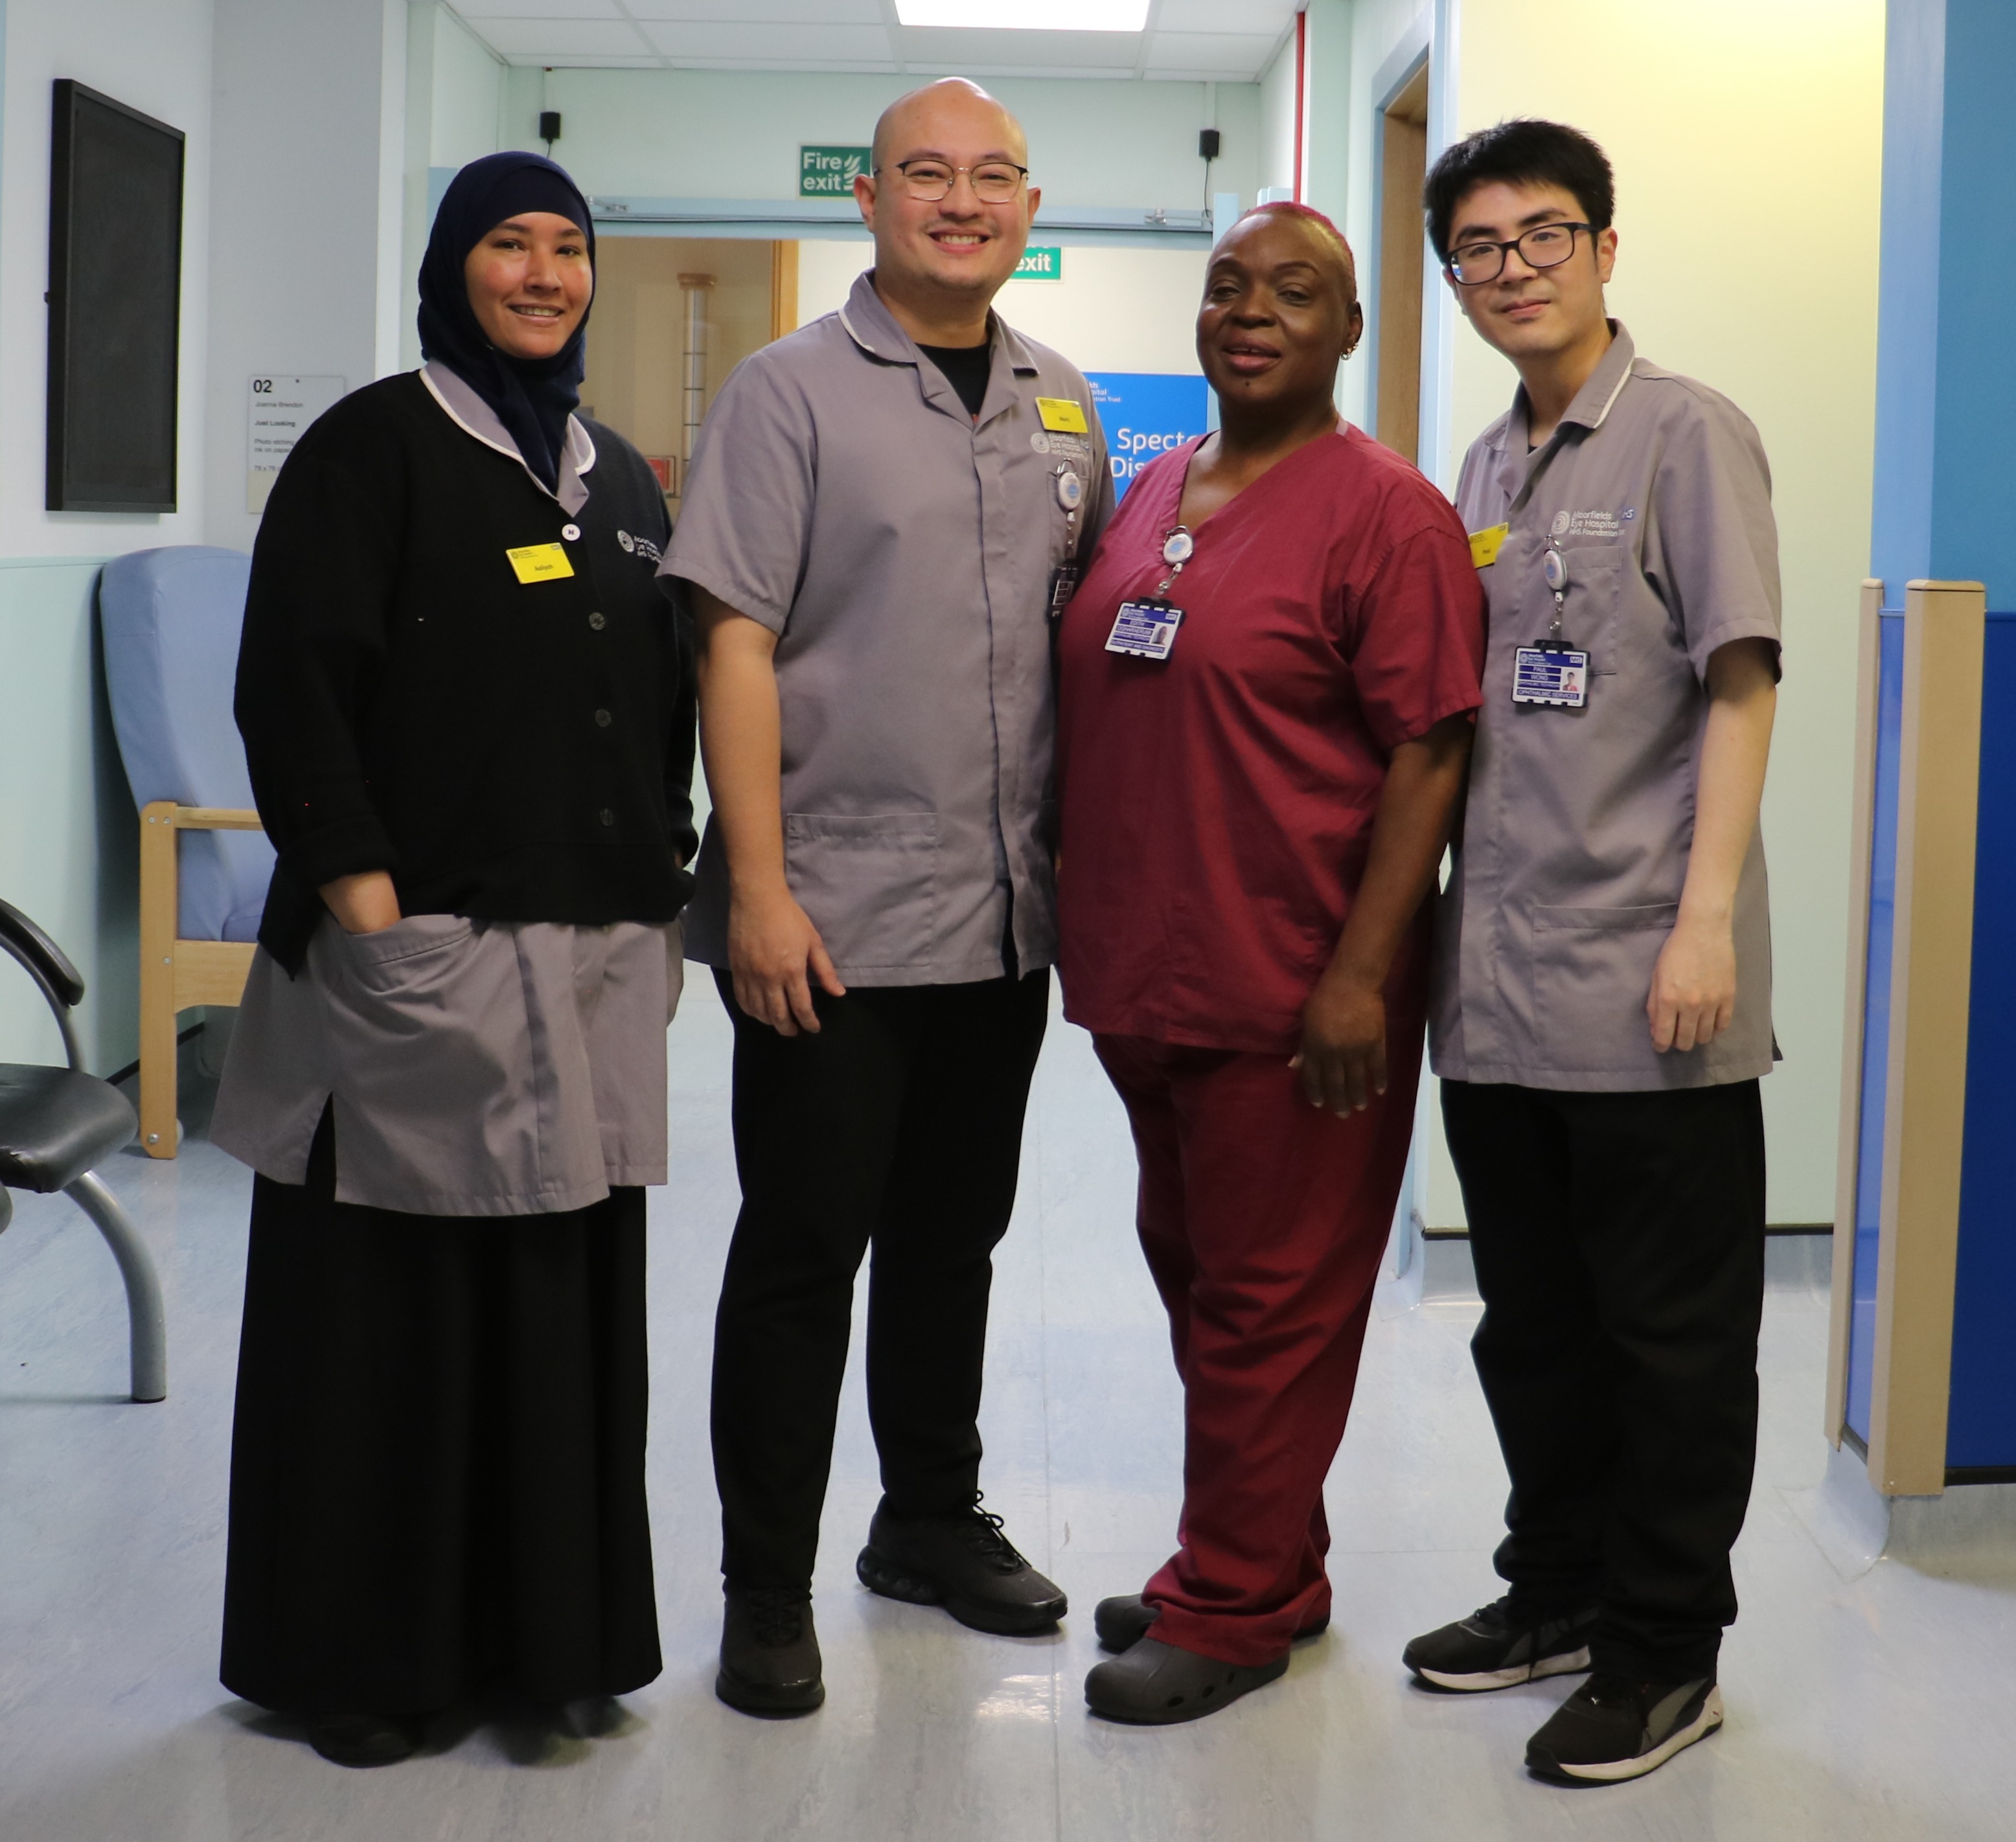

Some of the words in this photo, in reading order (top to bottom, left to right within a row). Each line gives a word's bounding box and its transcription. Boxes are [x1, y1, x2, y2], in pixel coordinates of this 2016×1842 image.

[803, 152, 842, 170] Fire
[803, 174, 841, 190] exit
[1015, 253, 1050, 271] exit
[253, 380, 272, 392] 02
[1117, 427, 1197, 455] Spect
[1571, 519, 1582, 529] Eye
[1585, 519, 1618, 529] Hospital
[1583, 529, 1618, 537] Foundation
